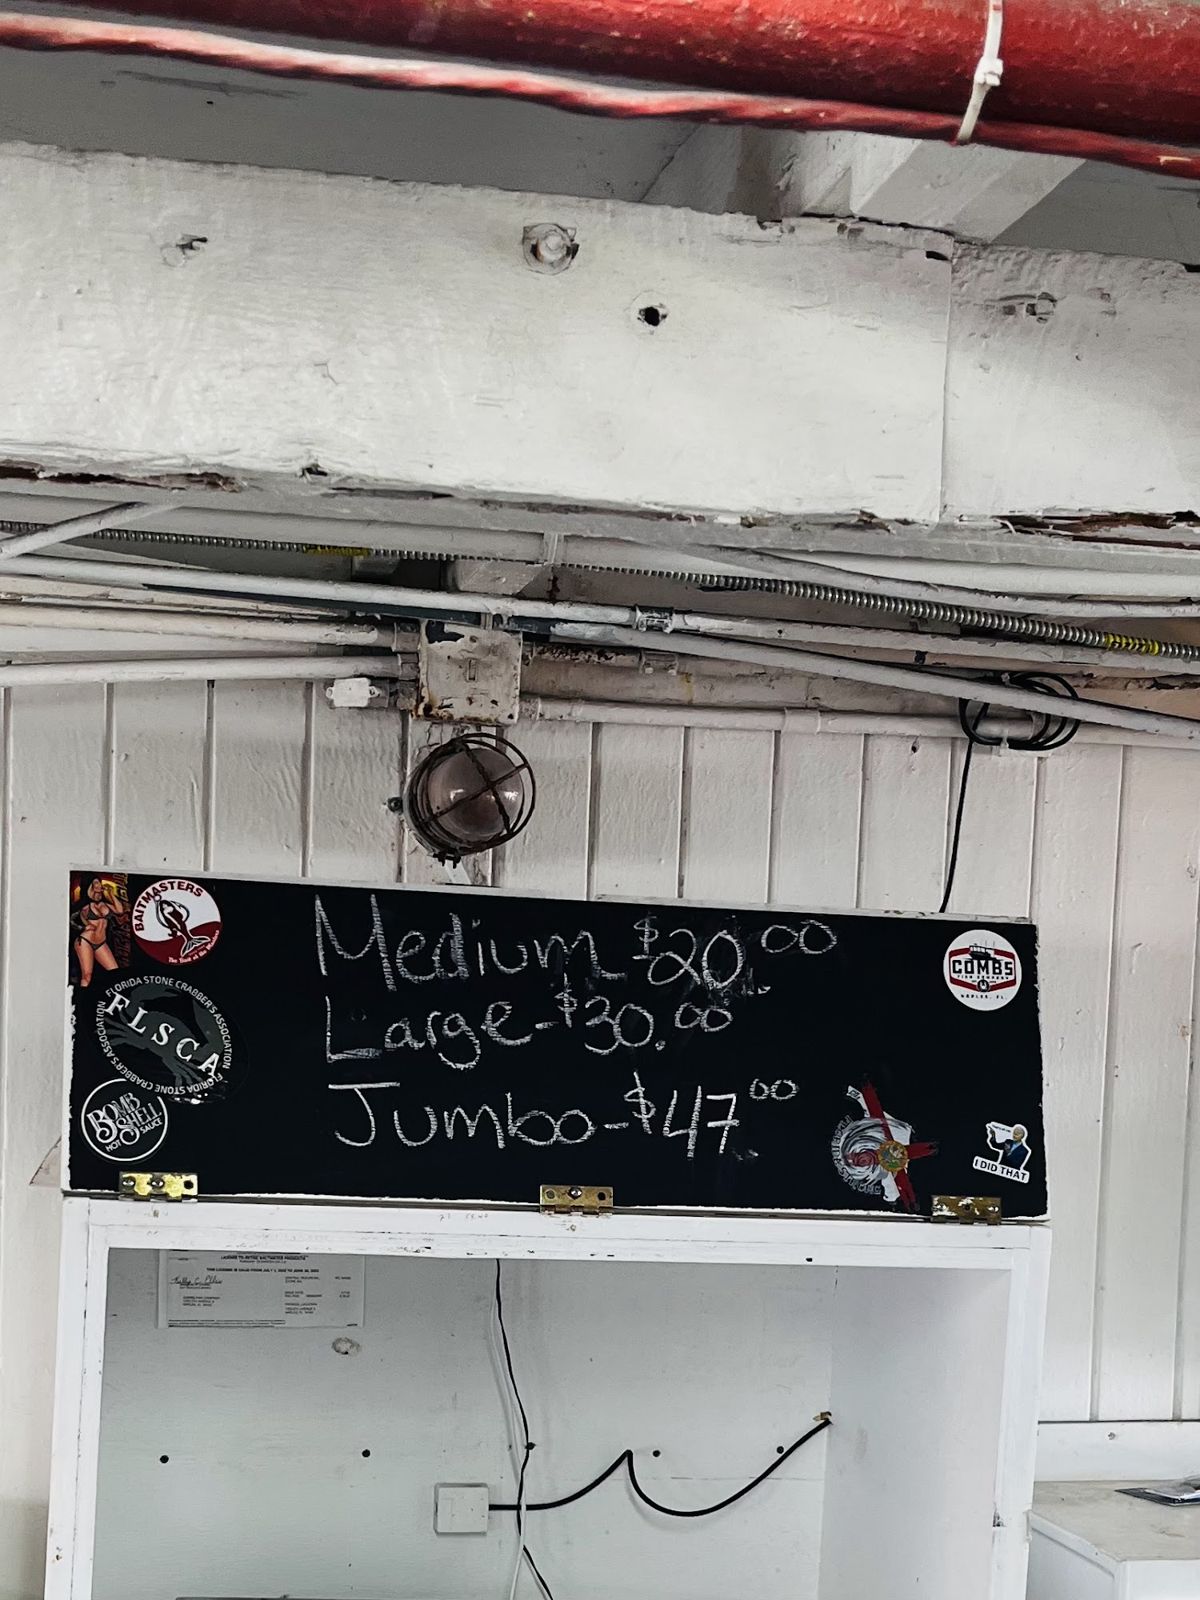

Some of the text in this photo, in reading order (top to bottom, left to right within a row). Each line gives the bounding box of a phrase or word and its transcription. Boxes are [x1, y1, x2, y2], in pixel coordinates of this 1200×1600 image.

[132, 880, 204, 932] BAITMASTERS
[952, 960, 1013, 976] COMBS
[105, 975, 233, 1070] FLORIDA STONE CRABBER'S ASSOCIATION
[95, 1000, 224, 1095] FLORIDA STONE CRABBER'S ASSOCIATION
[140, 1118, 164, 1134] SAUCE
[105, 1139, 122, 1153] HOT
[974, 1158, 1028, 1181] I DID THAT
